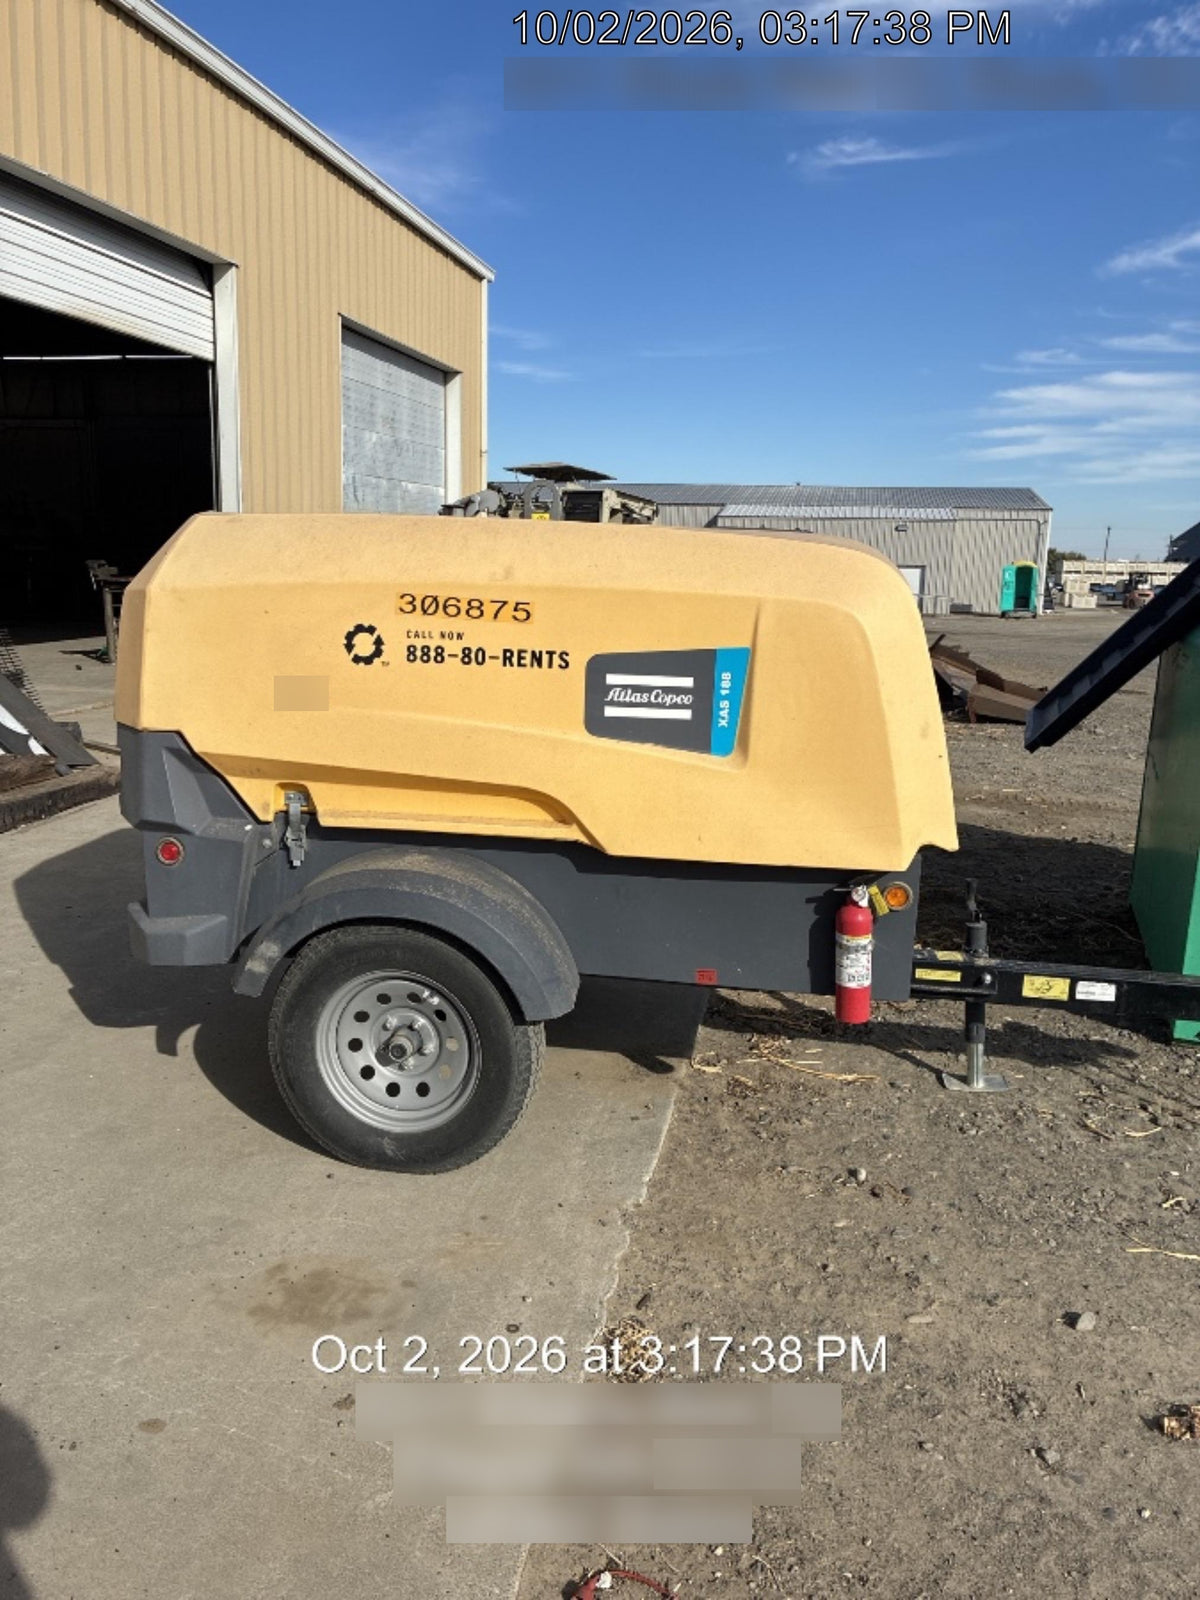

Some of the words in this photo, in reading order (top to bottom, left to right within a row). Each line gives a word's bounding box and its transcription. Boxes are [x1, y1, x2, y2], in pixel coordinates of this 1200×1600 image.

[398, 593, 532, 622] 306875
[406, 630, 434, 640] CALL
[440, 631, 465, 641] NOW
[406, 644, 570, 670] 888-80-RENTS
[604, 687, 650, 703] Atlas
[650, 689, 694, 706] Copco
[718, 700, 730, 728] XAS
